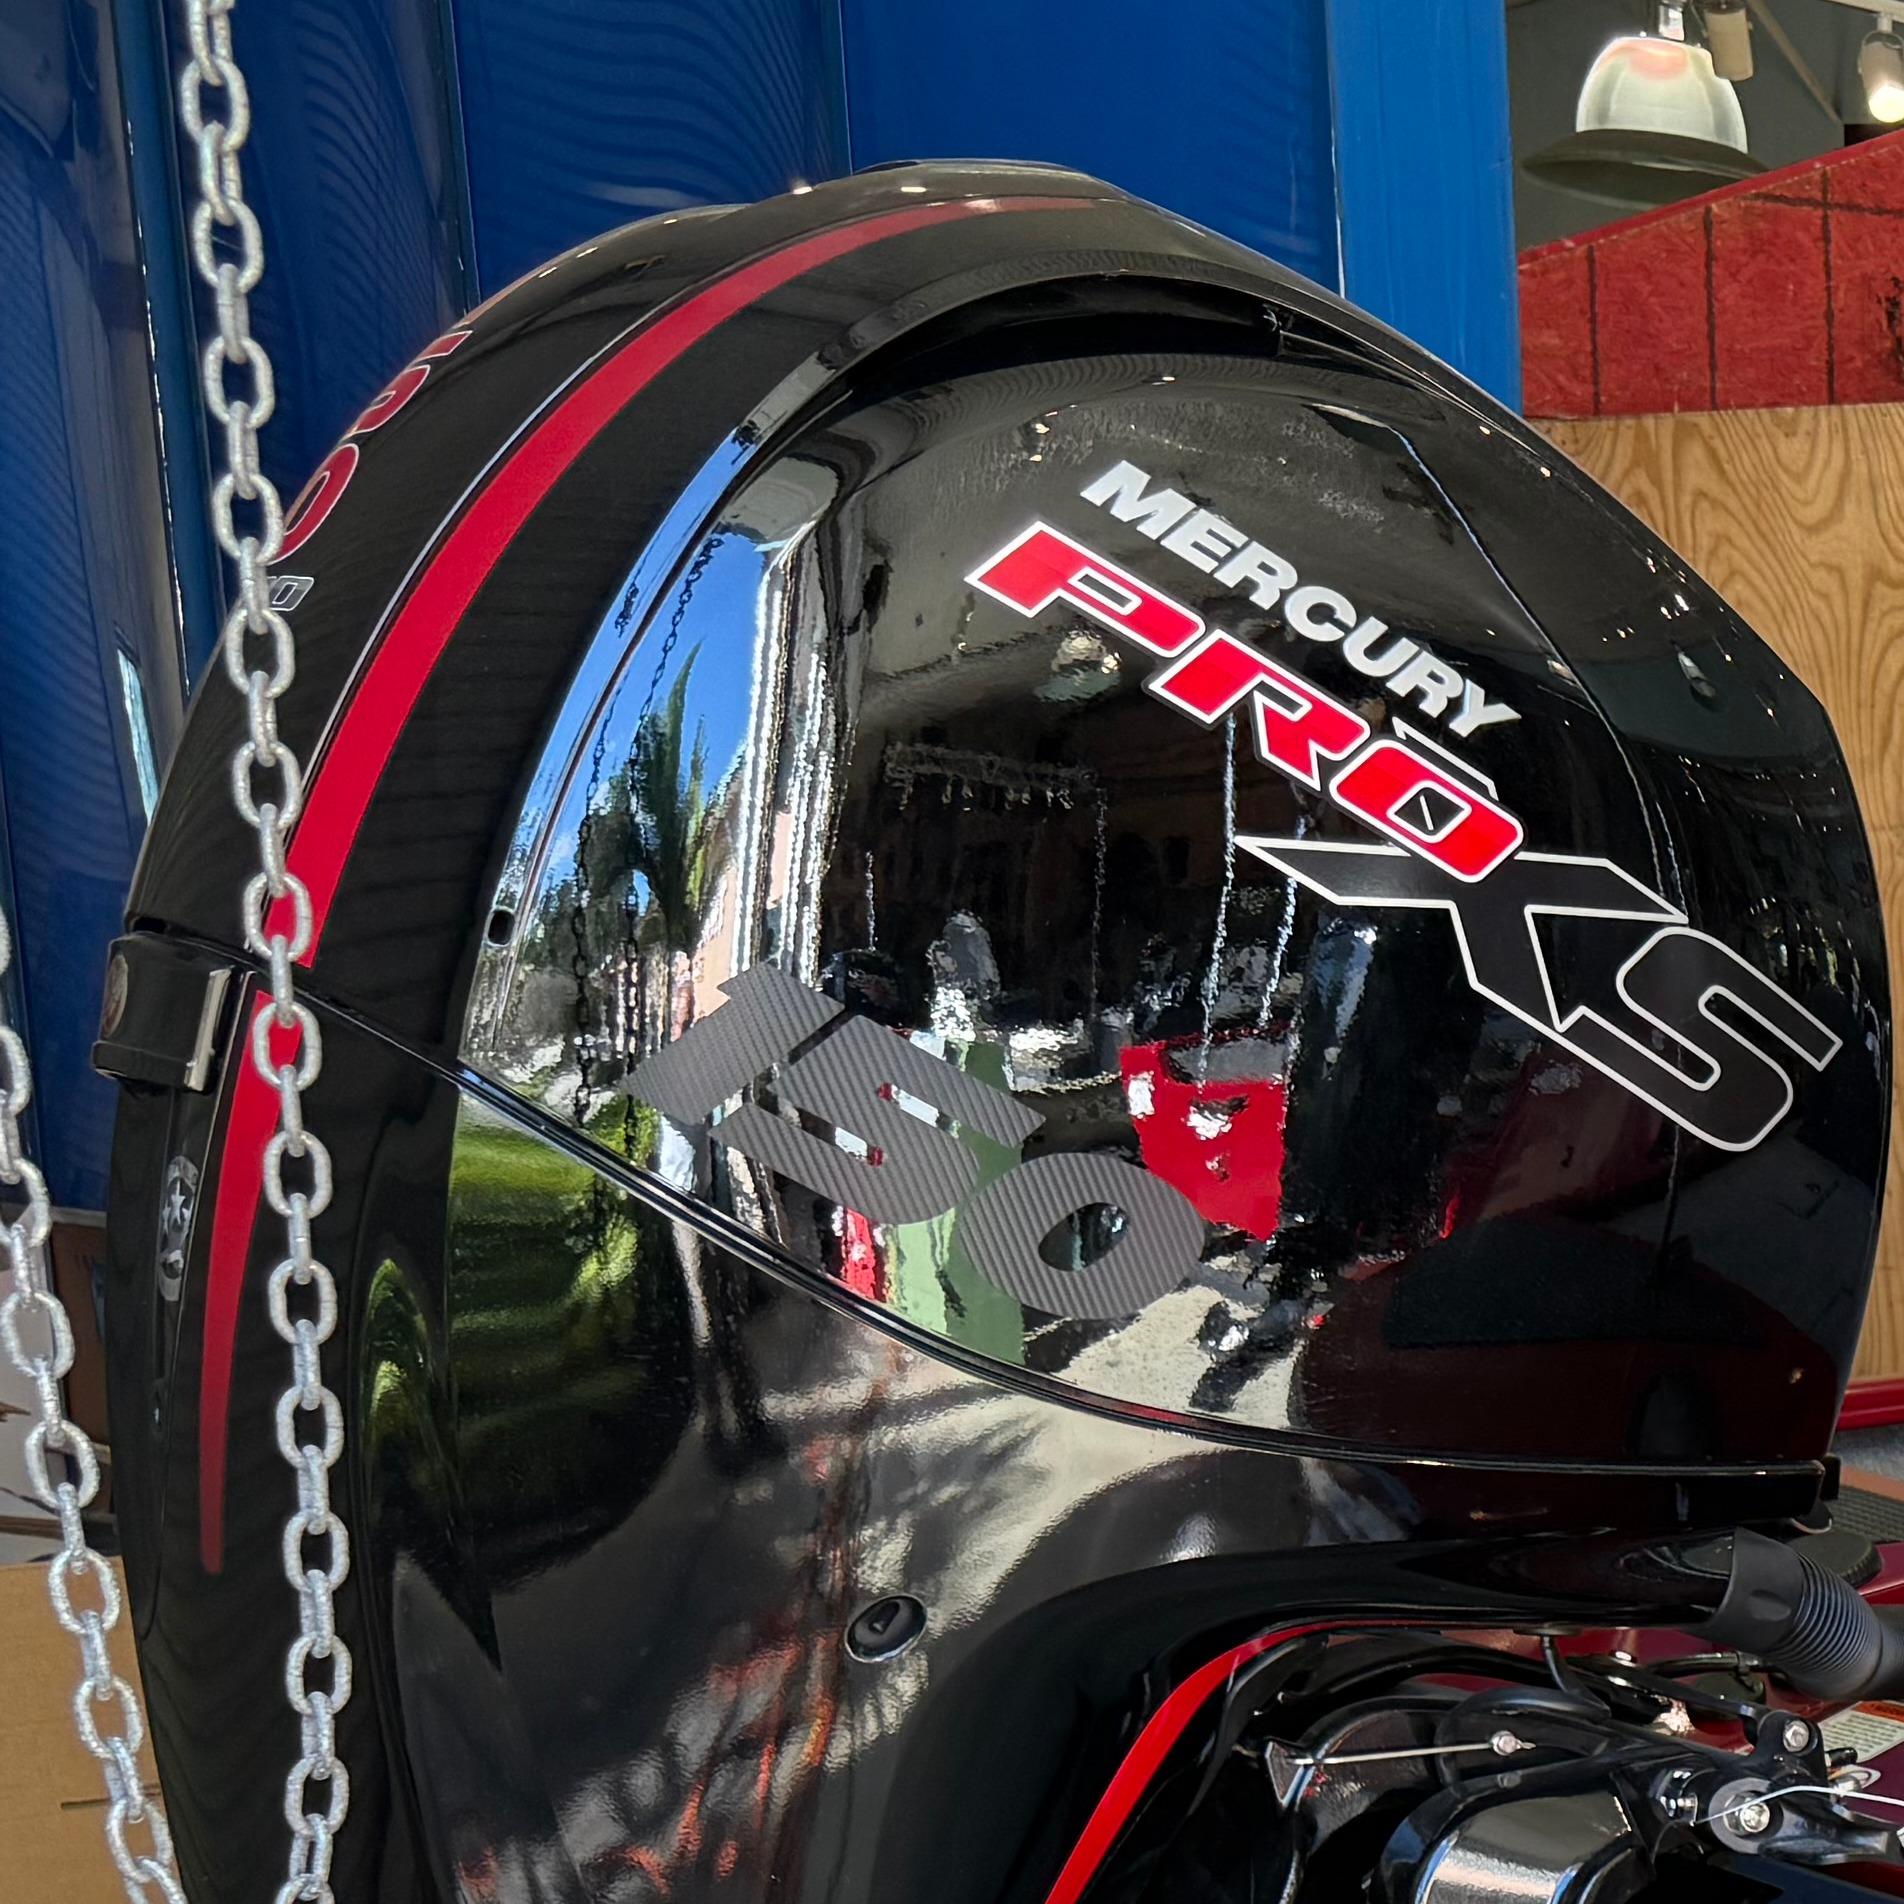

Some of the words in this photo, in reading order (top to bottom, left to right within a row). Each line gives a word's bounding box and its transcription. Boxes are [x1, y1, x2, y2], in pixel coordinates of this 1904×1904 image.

[964, 519, 1525, 884] PRO
[1079, 459, 1522, 739] MERCURY
[1235, 716, 1844, 1153] XS
[618, 961, 1205, 1322] 150
